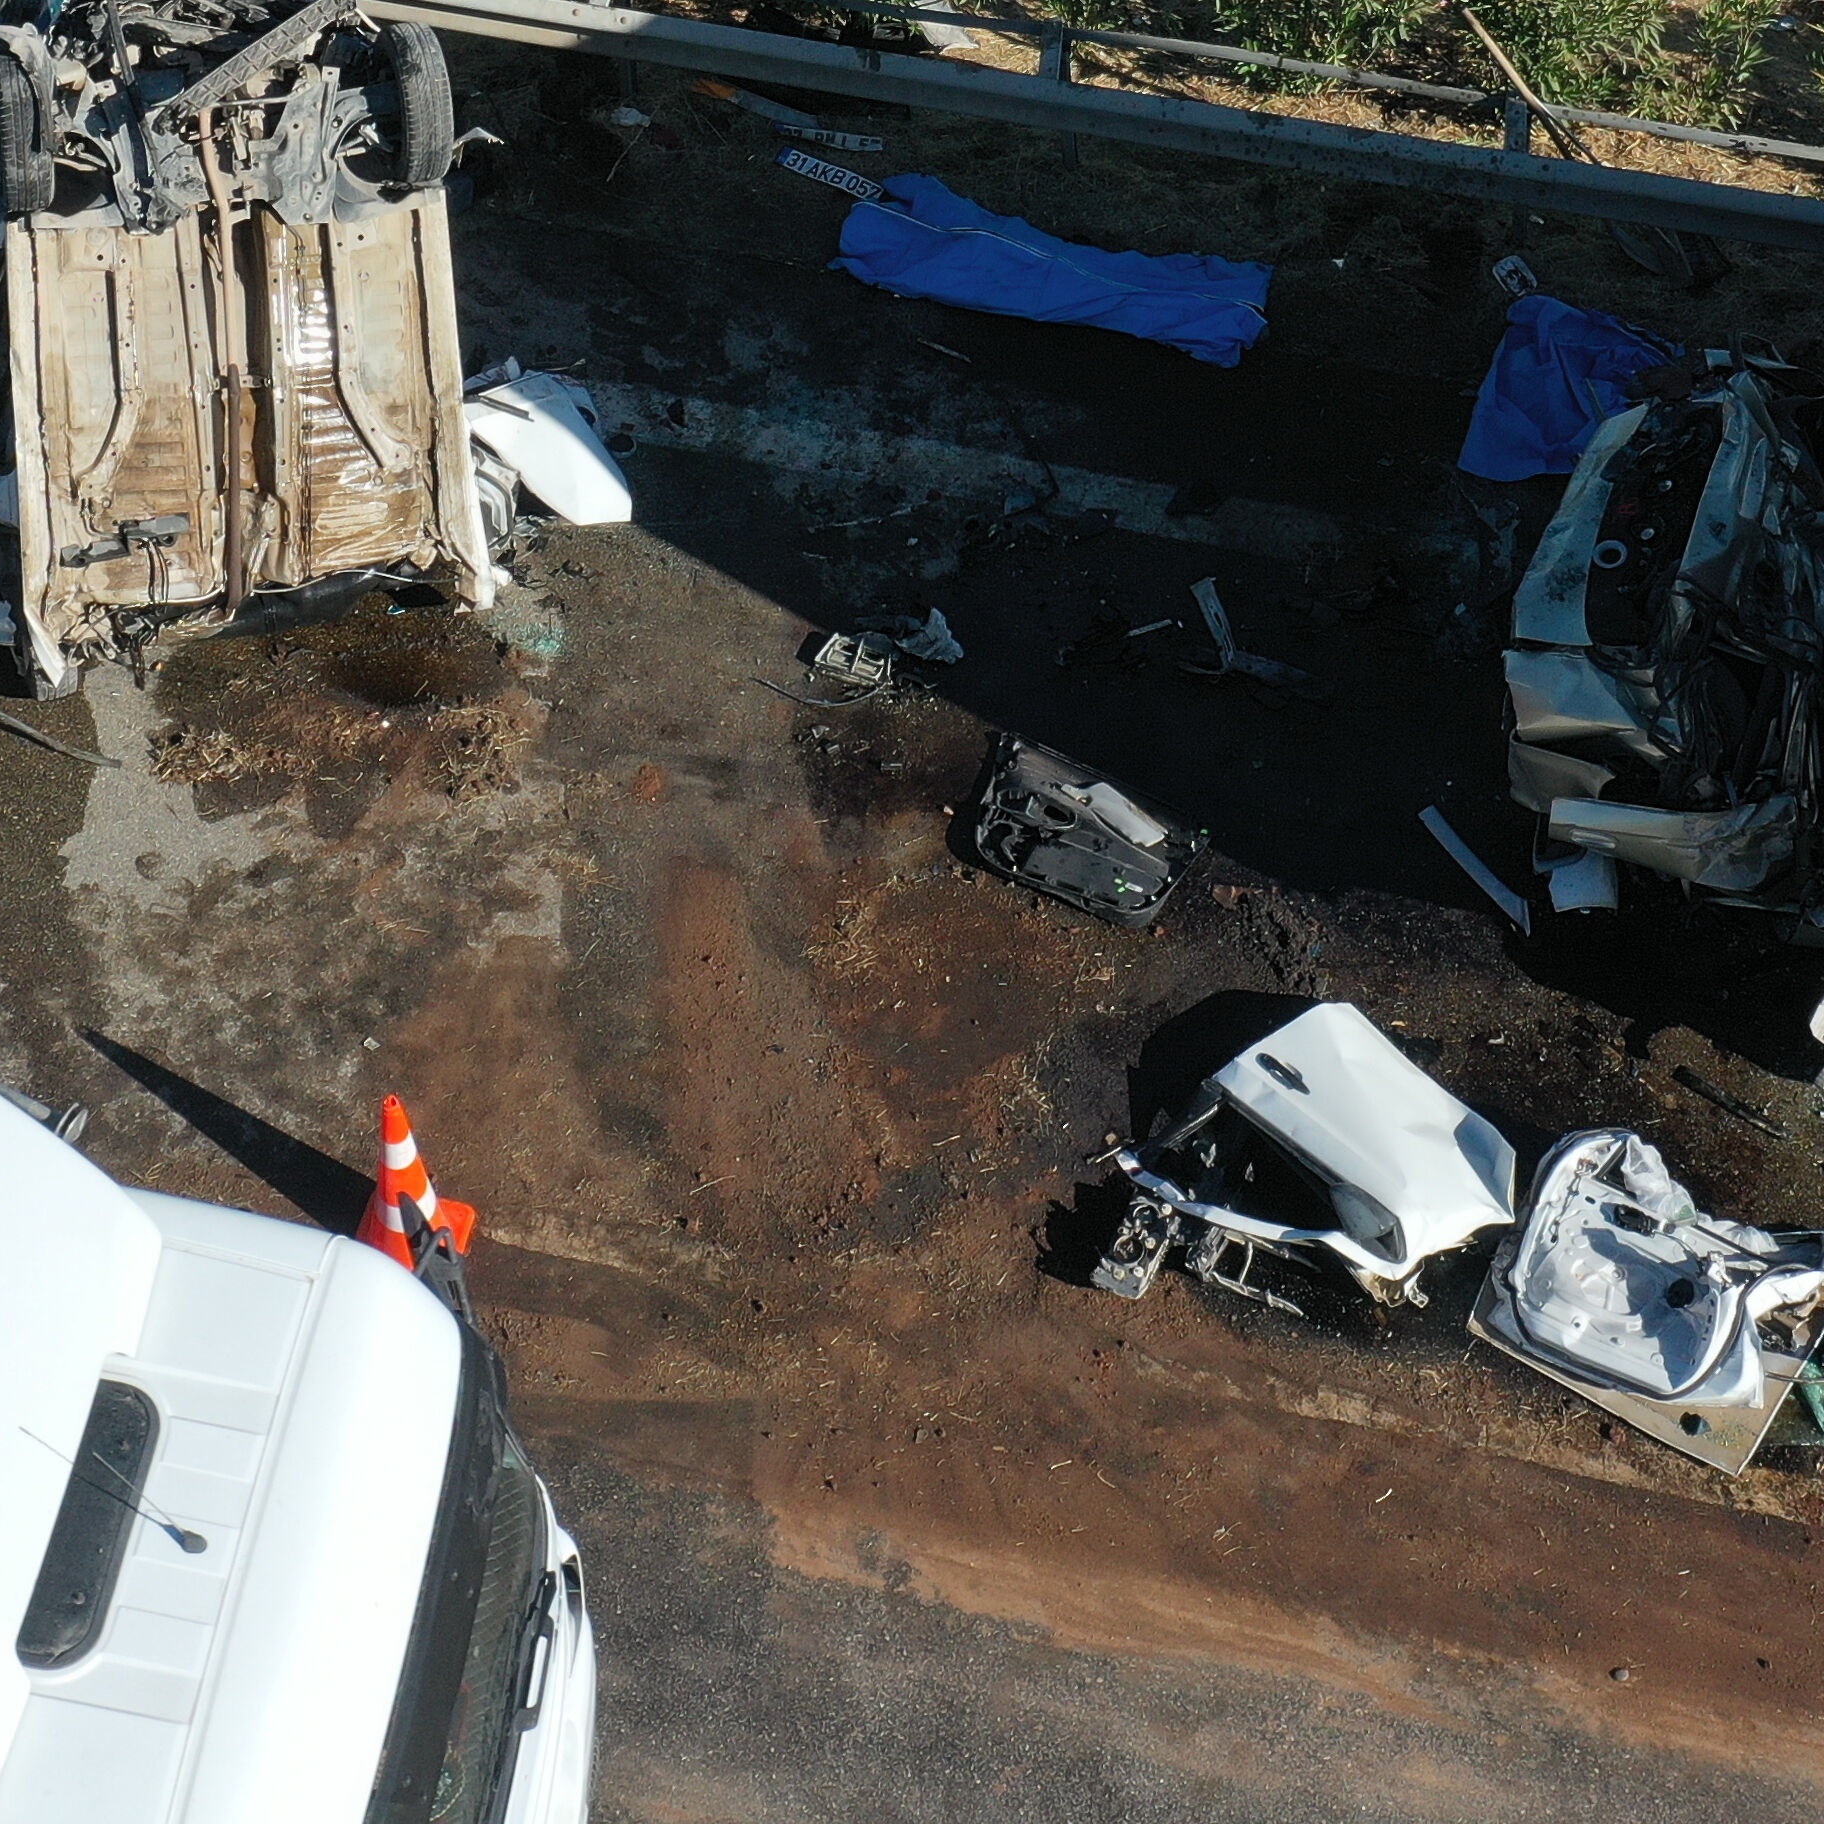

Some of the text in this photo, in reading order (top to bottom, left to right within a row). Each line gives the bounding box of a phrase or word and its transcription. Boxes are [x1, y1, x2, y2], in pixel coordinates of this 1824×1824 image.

[786, 152, 882, 199] 31 AKB 057
